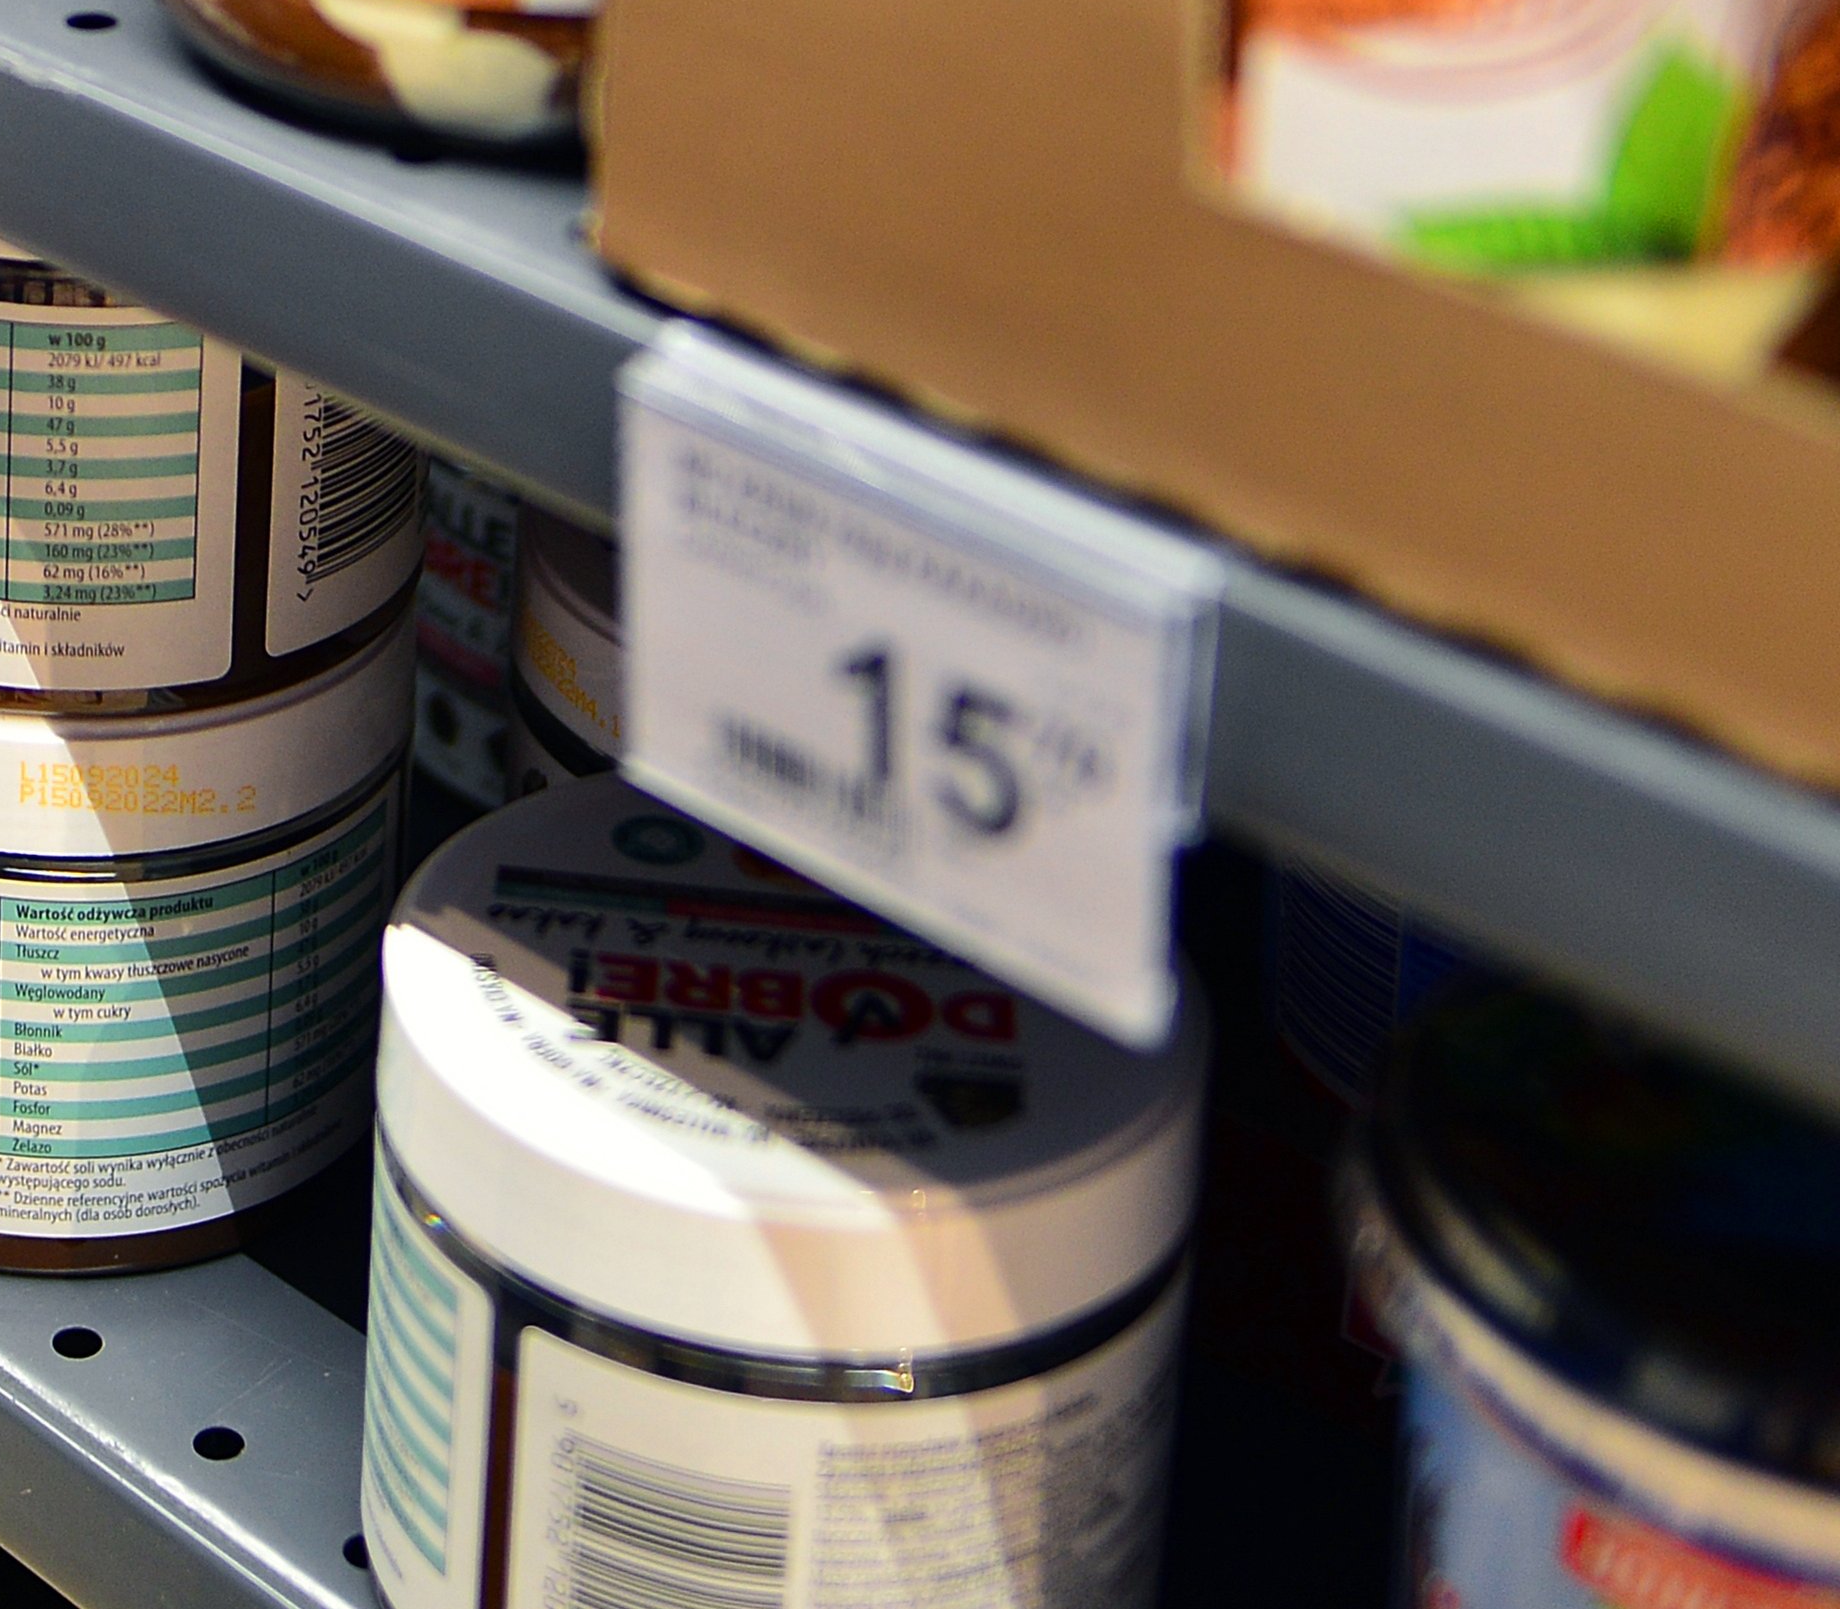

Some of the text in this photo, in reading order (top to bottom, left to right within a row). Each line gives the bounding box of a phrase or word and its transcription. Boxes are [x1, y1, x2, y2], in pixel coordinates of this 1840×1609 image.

[65, 332, 94, 348] 100
[47, 374, 65, 390] 38
[47, 395, 64, 410] 10
[46, 417, 63, 432] 47
[45, 438, 67, 455] 5,5
[45, 459, 66, 475] 3,7
[45, 480, 66, 496] 6,4
[44, 500, 74, 518] 0,09
[43, 523, 94, 541] 571 mg
[296, 476, 319, 576] 120549
[44, 544, 93, 561] 160 mg
[43, 564, 85, 583] 62 mg
[42, 583, 96, 603] 3,24 mg
[14, 605, 82, 623] naturalnie
[50, 642, 126, 658] składników
[835, 637, 1028, 838] 15
[20, 762, 180, 788] L15092024
[15, 895, 214, 924] Wartość odżywcza produktu
[15, 924, 156, 943] Wartość energetyczna
[15, 943, 60, 960] Tłuszcz
[40, 944, 250, 983] w tym kwasy tłuszczowe nasycone
[14, 983, 107, 1001] Węglowodany
[569, 947, 1016, 1045] DOBRE!
[53, 1004, 132, 1021] w tym cukry
[14, 1022, 63, 1038] Błonnik
[13, 1042, 53, 1058] Białko
[13, 1081, 48, 1096] Potas
[12, 1100, 51, 1116] Fosfor
[12, 1119, 63, 1137] Magnez
[5, 1157, 72, 1175] Zawartość
[73, 1160, 95, 1175] soli
[97, 1160, 144, 1179] wynika
[146, 1148, 206, 1172] wyłącznie
[216, 1129, 271, 1156] obecności
[12, 1136, 53, 1154] Żelazo
[13, 1169, 247, 1211] Dzienne referencyjne wartości spożycia
[92, 1174, 127, 1189] sodu.
[75, 1207, 100, 1224] (dla
[102, 1205, 133, 1221] osób
[134, 1195, 202, 1220] dorosłych).
